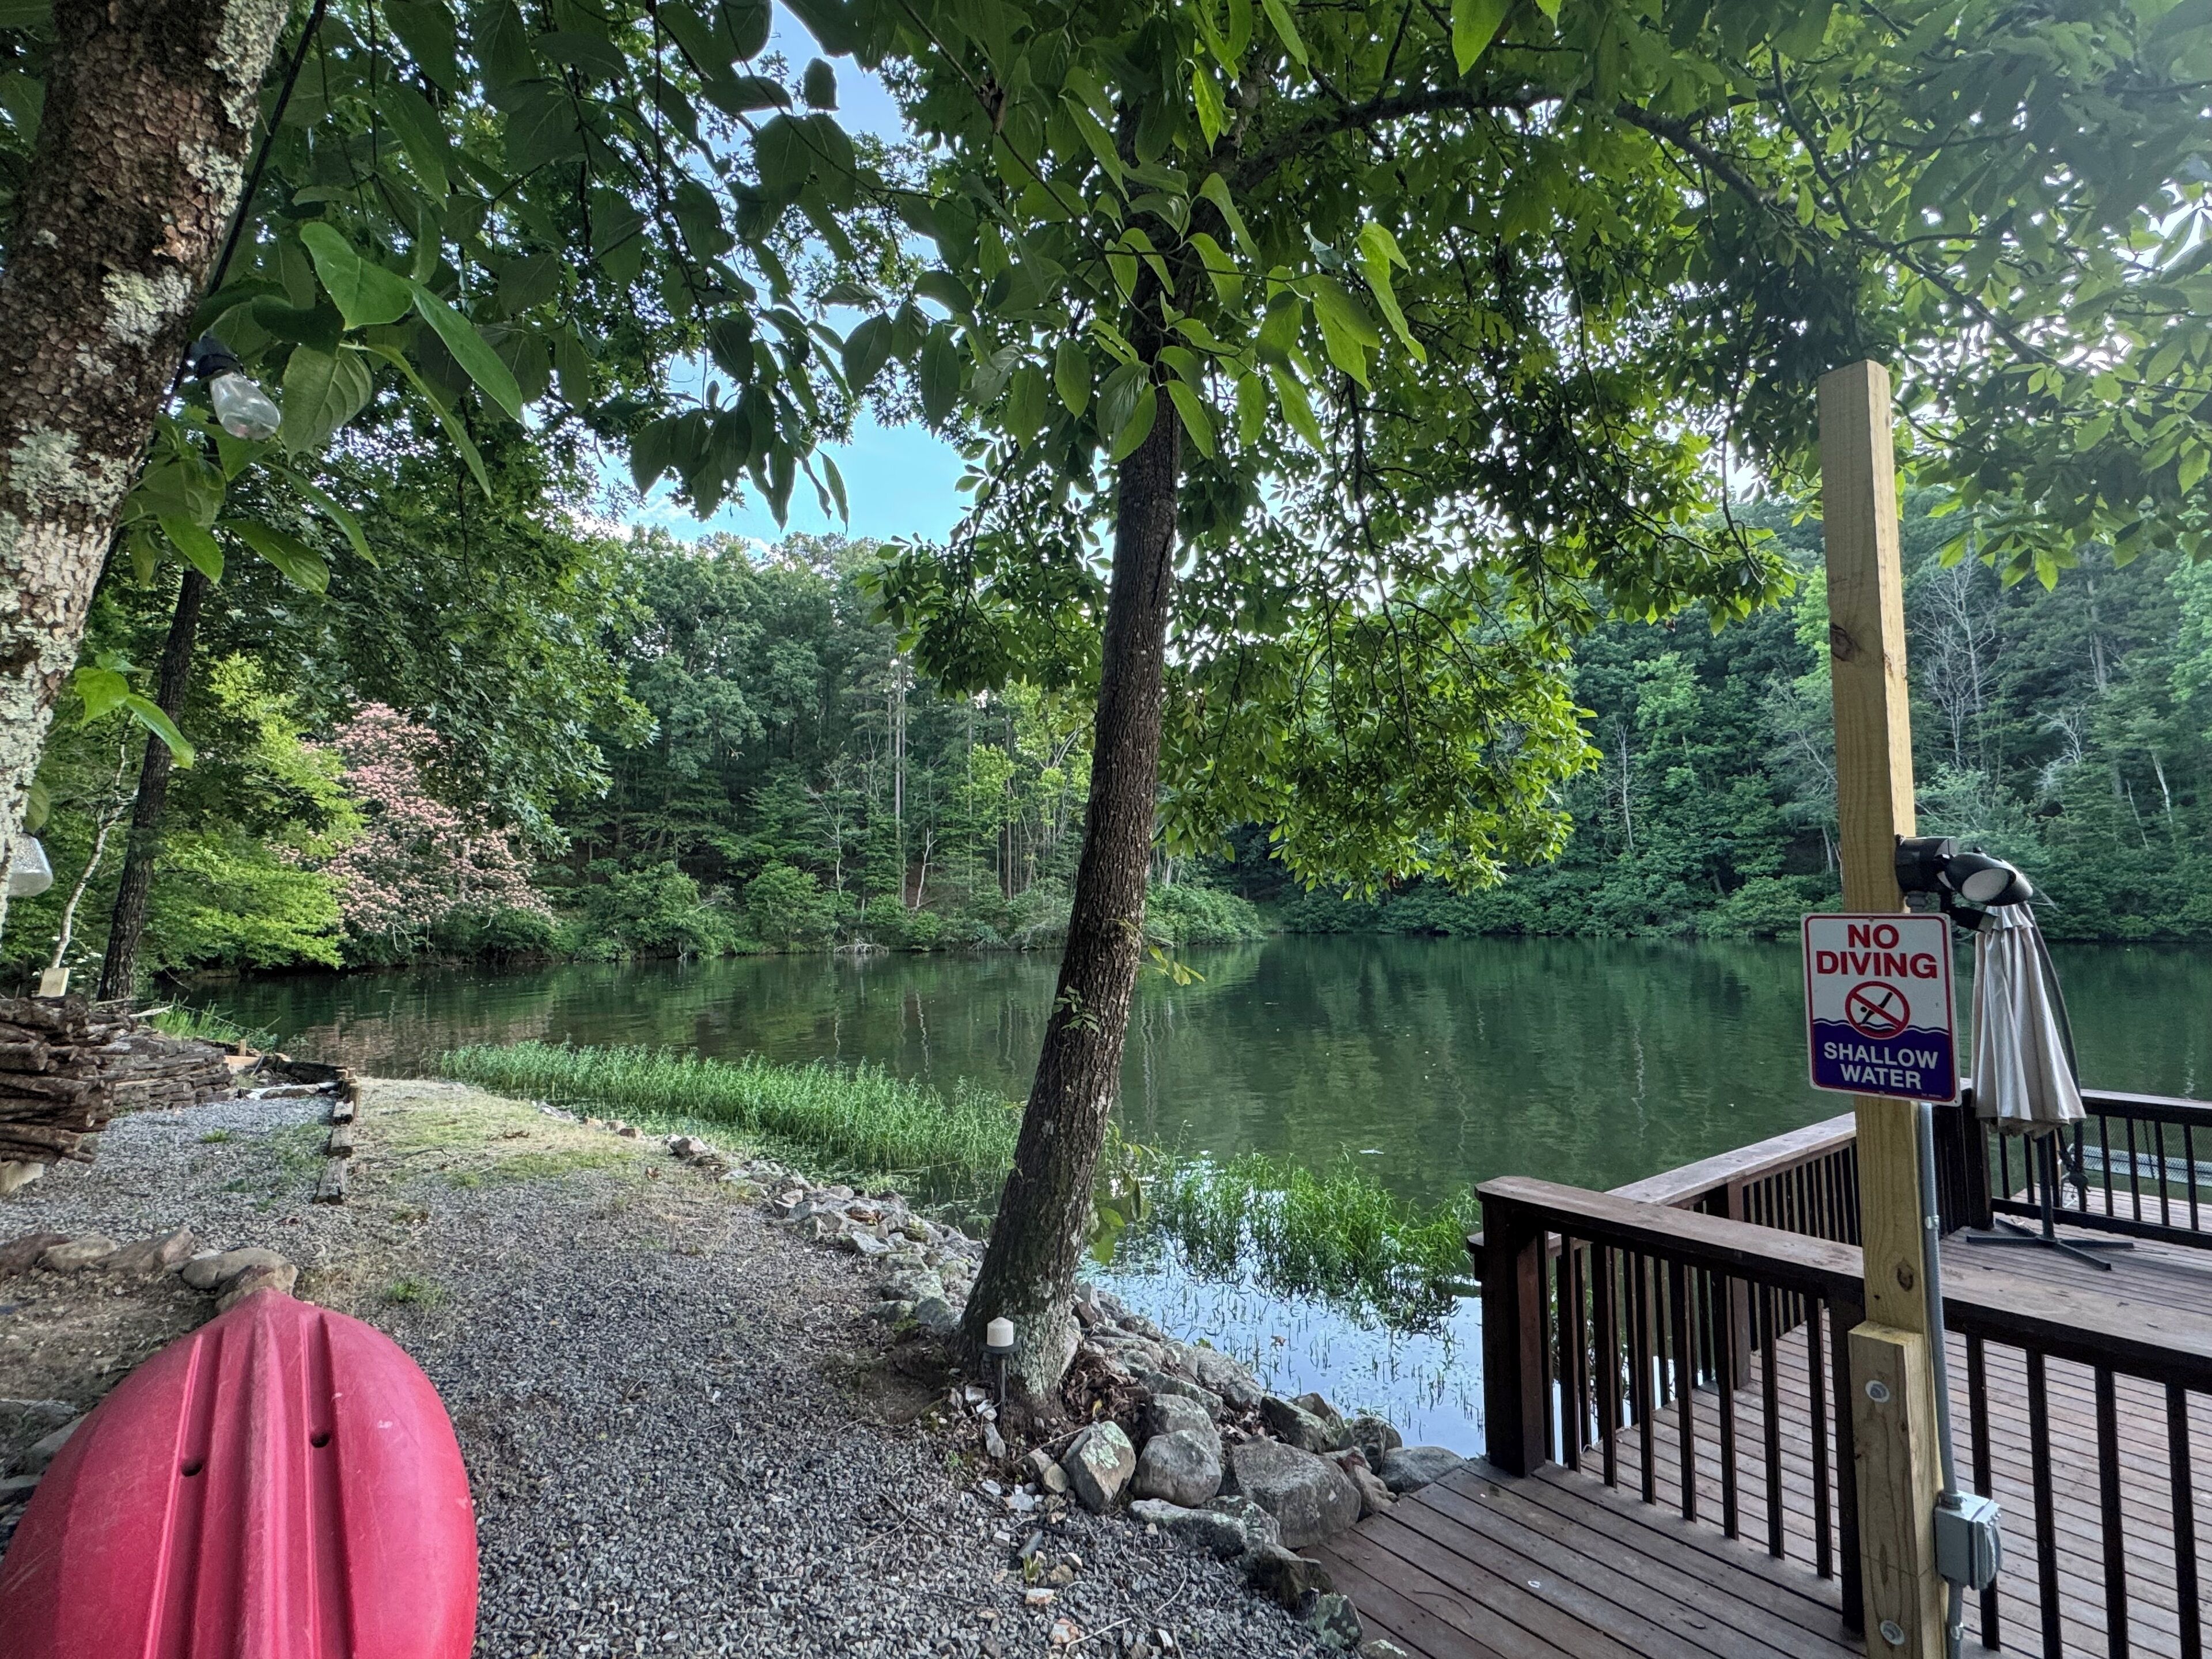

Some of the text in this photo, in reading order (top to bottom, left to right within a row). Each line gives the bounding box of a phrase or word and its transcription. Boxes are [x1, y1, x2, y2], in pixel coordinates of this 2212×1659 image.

[1847, 924, 1899, 949] NO
[1816, 950, 1938, 978] DIVING
[1824, 1042, 1938, 1069] SHALLOW
[1840, 1063, 1922, 1089] WATER
